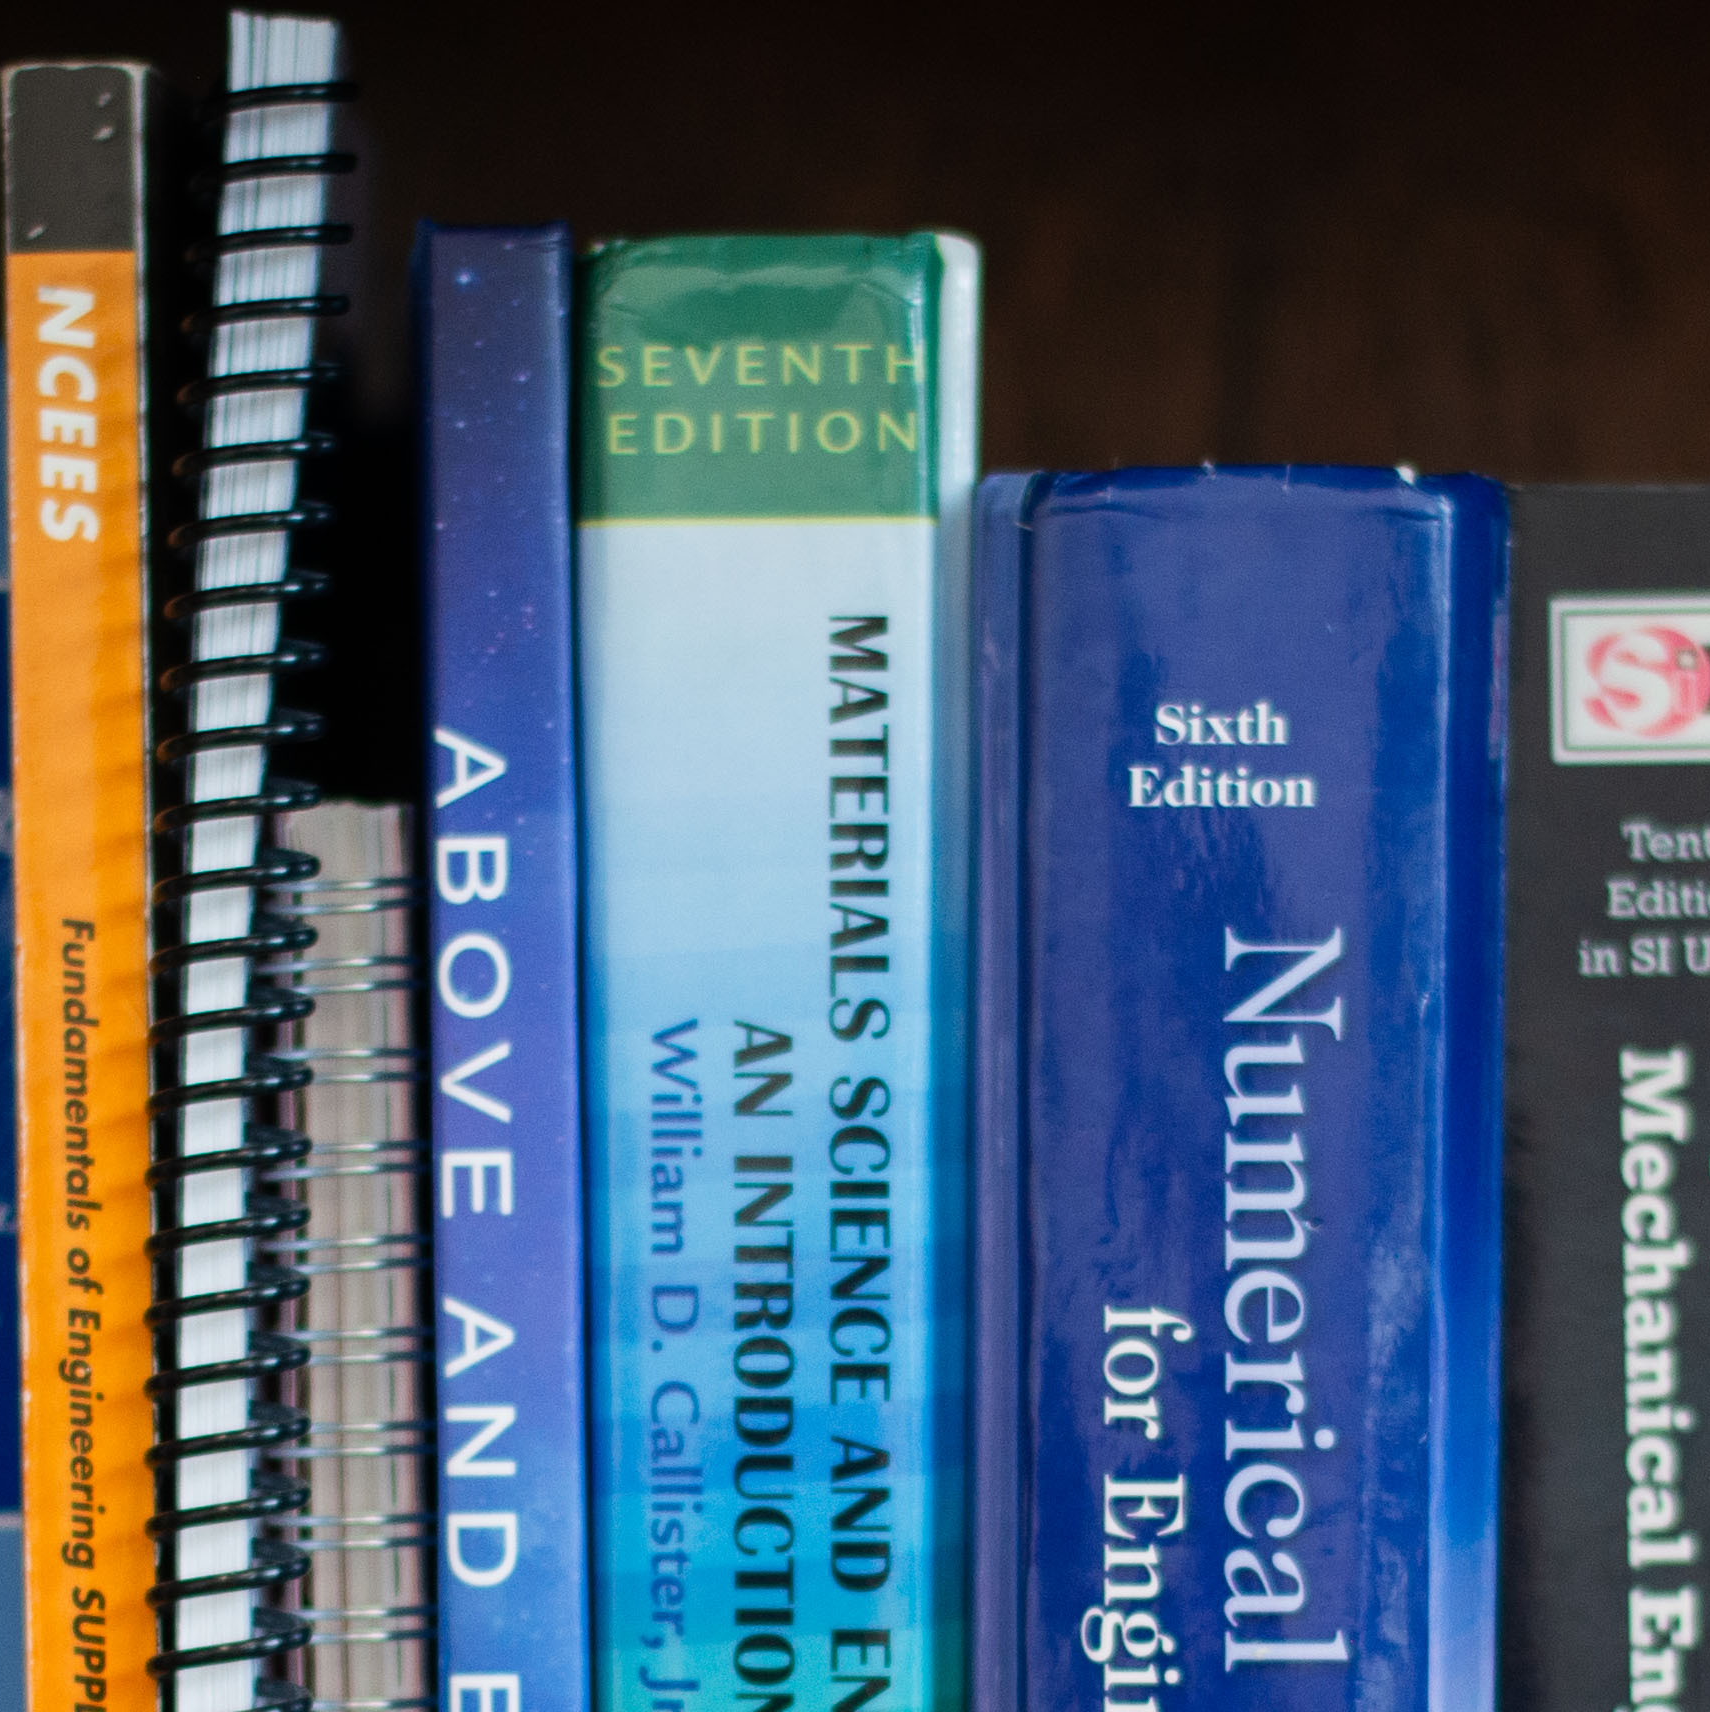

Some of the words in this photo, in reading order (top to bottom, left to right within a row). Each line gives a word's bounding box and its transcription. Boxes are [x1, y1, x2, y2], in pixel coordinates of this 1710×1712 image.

[37, 286, 99, 542] NCEES
[596, 343, 925, 388] SEVENTH
[609, 410, 919, 456] EDITION
[828, 614, 890, 1044] MATERIALS
[1128, 765, 1316, 809] Edition
[1154, 702, 1288, 748] Sixth
[436, 728, 515, 1216] ABOVE
[734, 1019, 791, 1118] AN
[1579, 940, 1621, 976] in
[1631, 936, 1673, 974] SI
[61, 916, 102, 1231] Fundamentals
[649, 1022, 705, 1255] William
[69, 1247, 105, 1297] of
[651, 1284, 700, 1354] D.
[829, 1075, 891, 1405] SCIENCE
[1222, 926, 1351, 1671] Numerical
[1619, 1048, 1699, 1565] Mechanical
[59, 1307, 107, 1571] Engineering
[442, 1298, 519, 1589] AND
[1102, 1306, 1193, 1438] for
[638, 1377, 706, 1652] Callister,
[829, 1436, 891, 1593] AND
